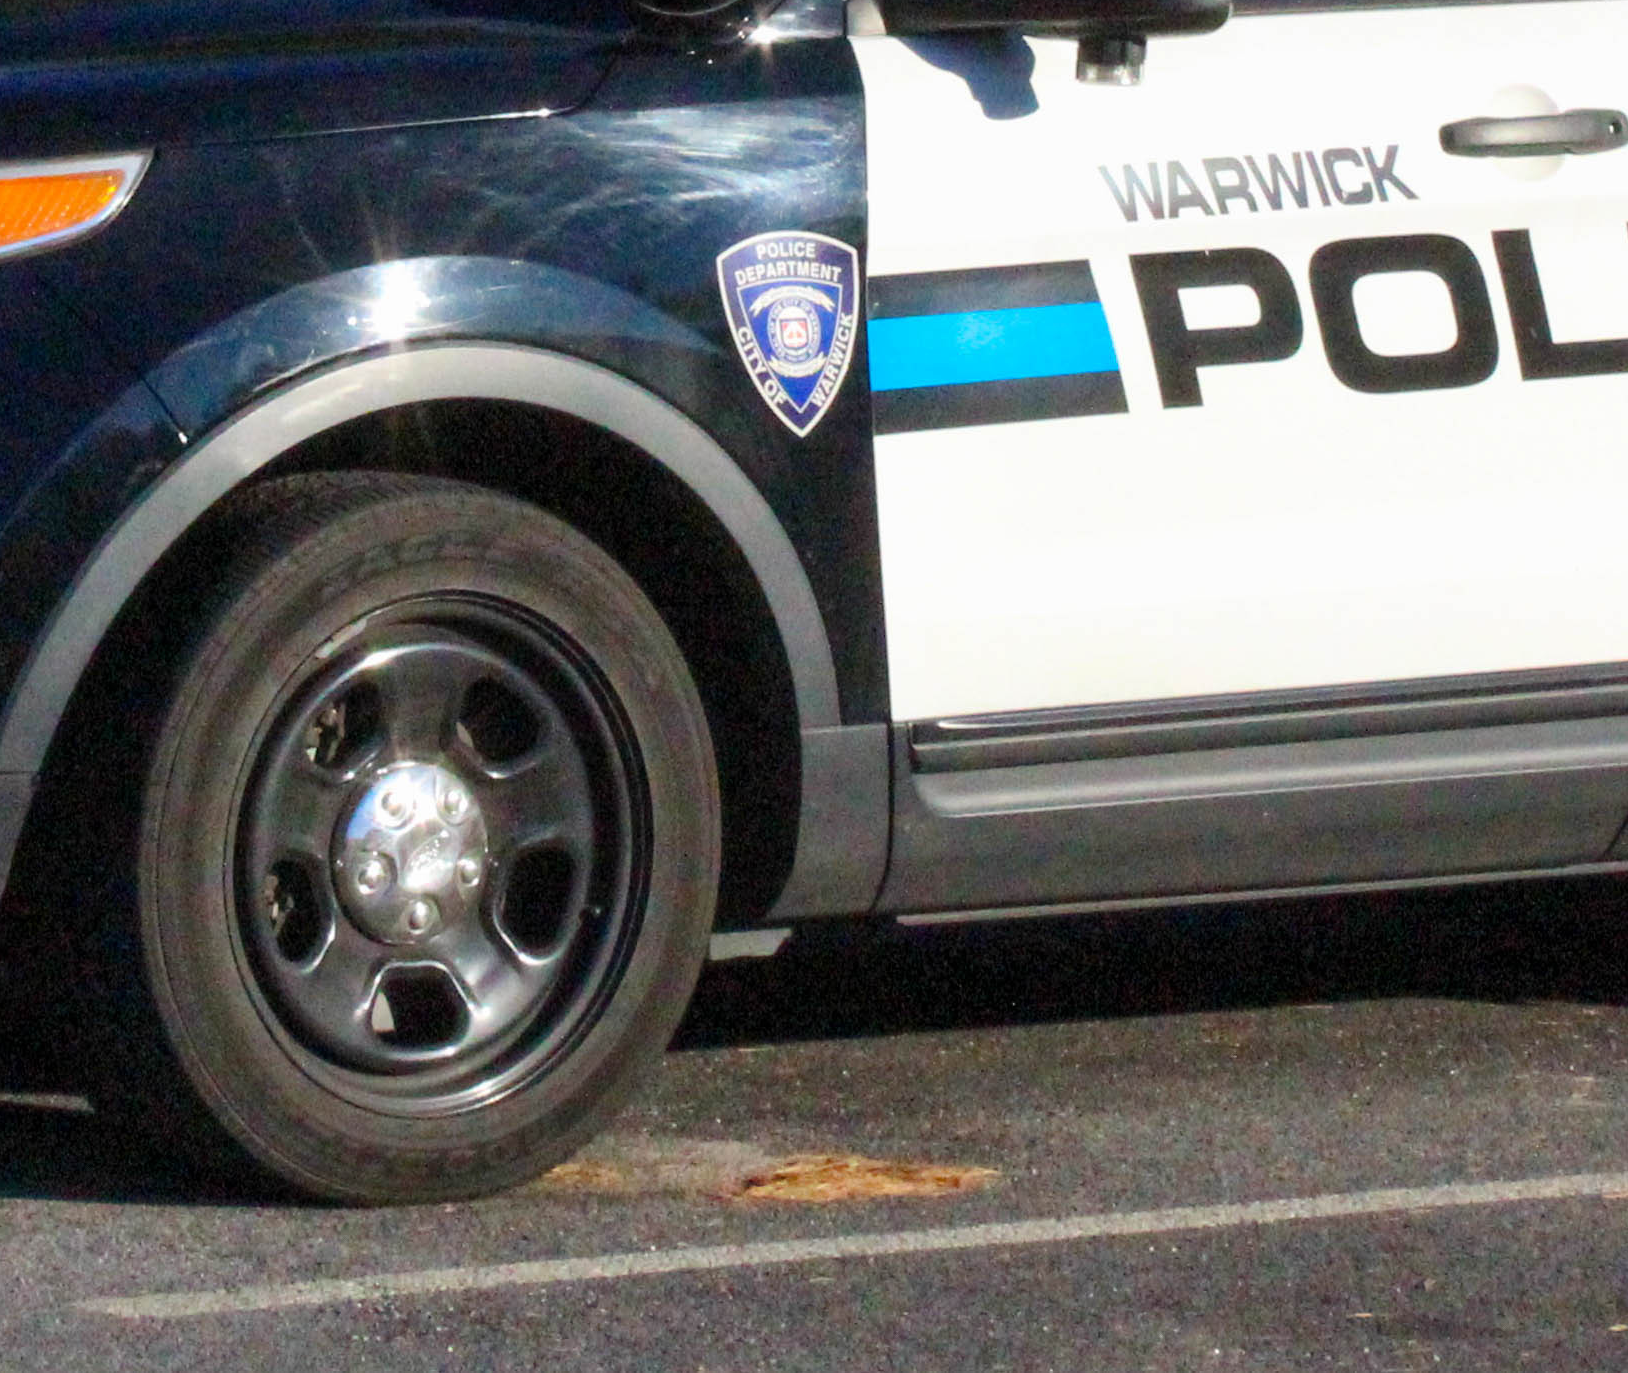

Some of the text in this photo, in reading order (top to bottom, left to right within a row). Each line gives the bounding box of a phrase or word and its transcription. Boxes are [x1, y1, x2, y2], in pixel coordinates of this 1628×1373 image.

[1098, 145, 1419, 223] WARWICK
[734, 260, 842, 285] DEPARTMENT
[756, 241, 816, 259] POLICE
[737, 326, 768, 378] CITY
[763, 377, 789, 406] OF
[809, 311, 853, 409] WARWICK
